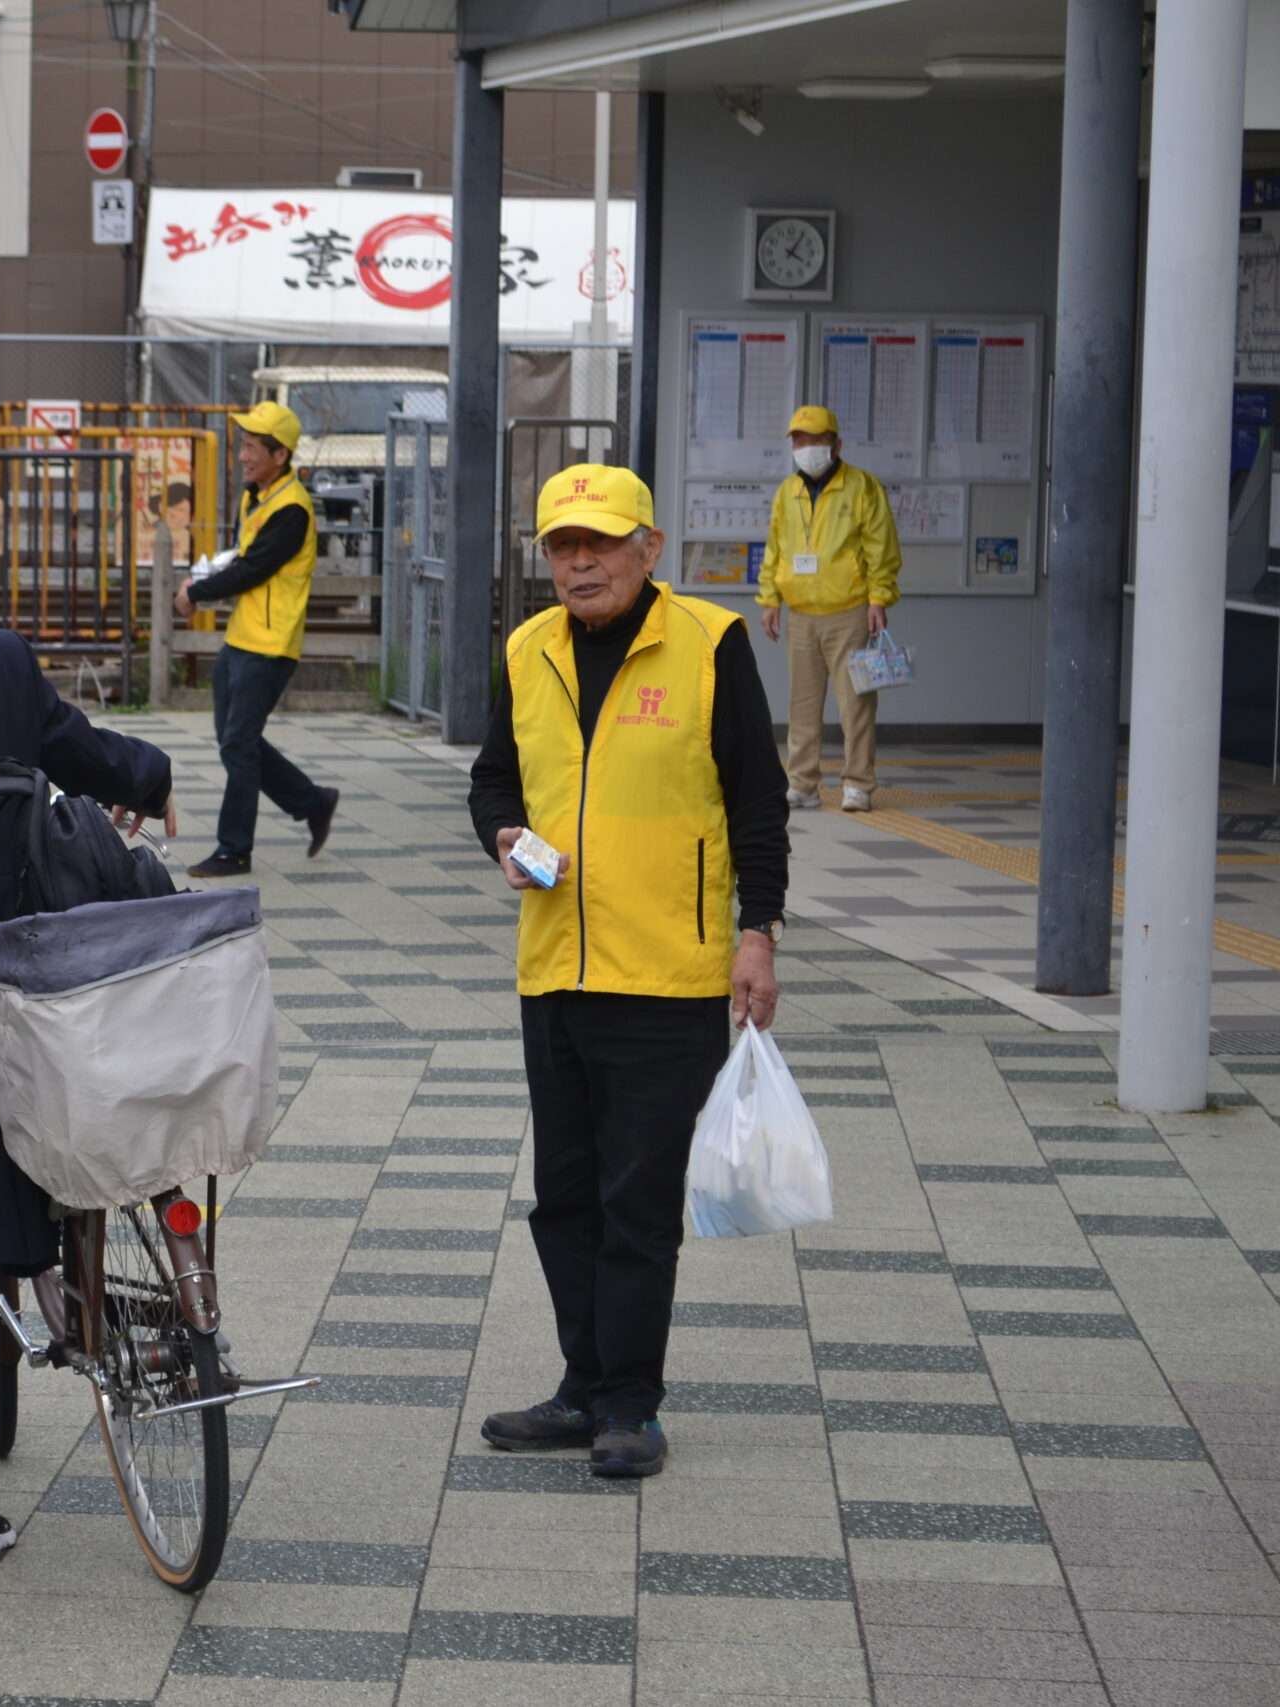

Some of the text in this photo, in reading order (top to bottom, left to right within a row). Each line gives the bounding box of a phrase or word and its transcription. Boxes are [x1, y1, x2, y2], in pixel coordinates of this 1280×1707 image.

[162, 202, 317, 261] 立呑み
[358, 255, 453, 271] KAORUY
